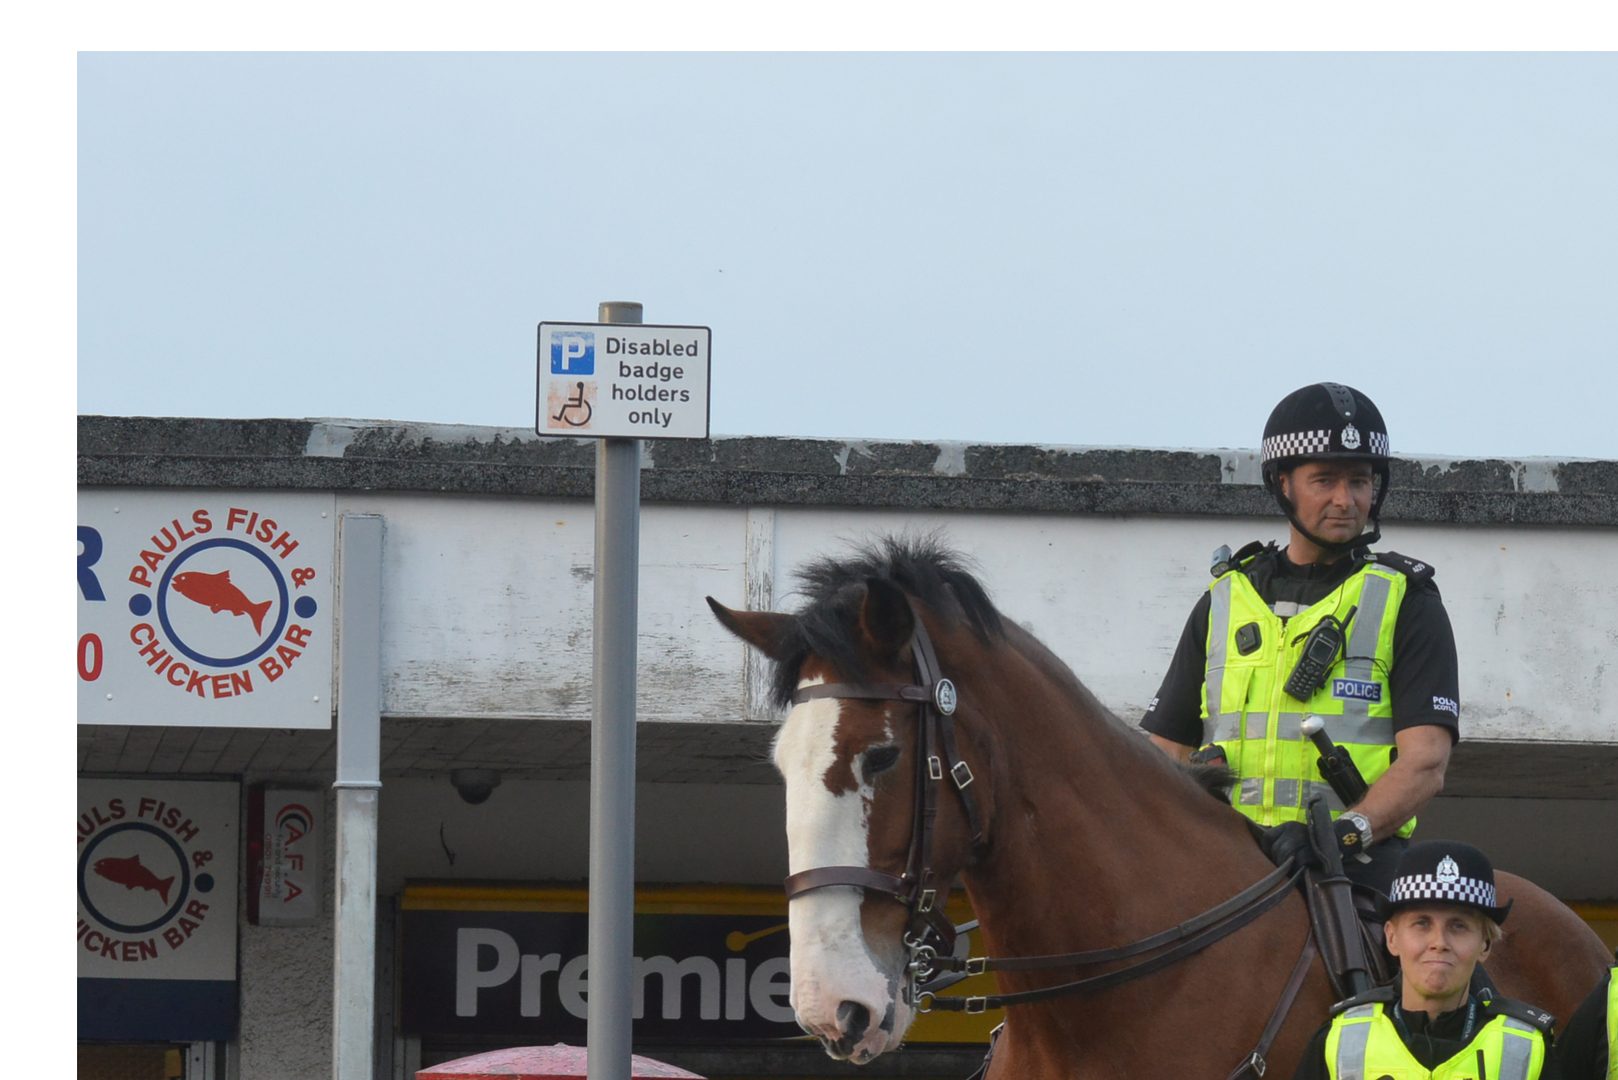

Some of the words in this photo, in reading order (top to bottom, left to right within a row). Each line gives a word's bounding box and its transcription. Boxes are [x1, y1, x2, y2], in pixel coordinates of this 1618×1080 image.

[606, 337, 698, 357] Disabled
[619, 361, 684, 382] badge
[612, 383, 690, 402] holders
[628, 407, 673, 428] only
[128, 508, 213, 588] PAULS
[226, 507, 300, 559] FISH
[291, 567, 316, 589] &
[129, 622, 254, 699] CHICKEN
[258, 623, 313, 683] BAR
[1336, 681, 1379, 699] POLICE
[137, 797, 200, 843] FISH
[192, 850, 214, 869] &
[162, 899, 210, 950] BAR
[456, 927, 791, 1023] Premie
